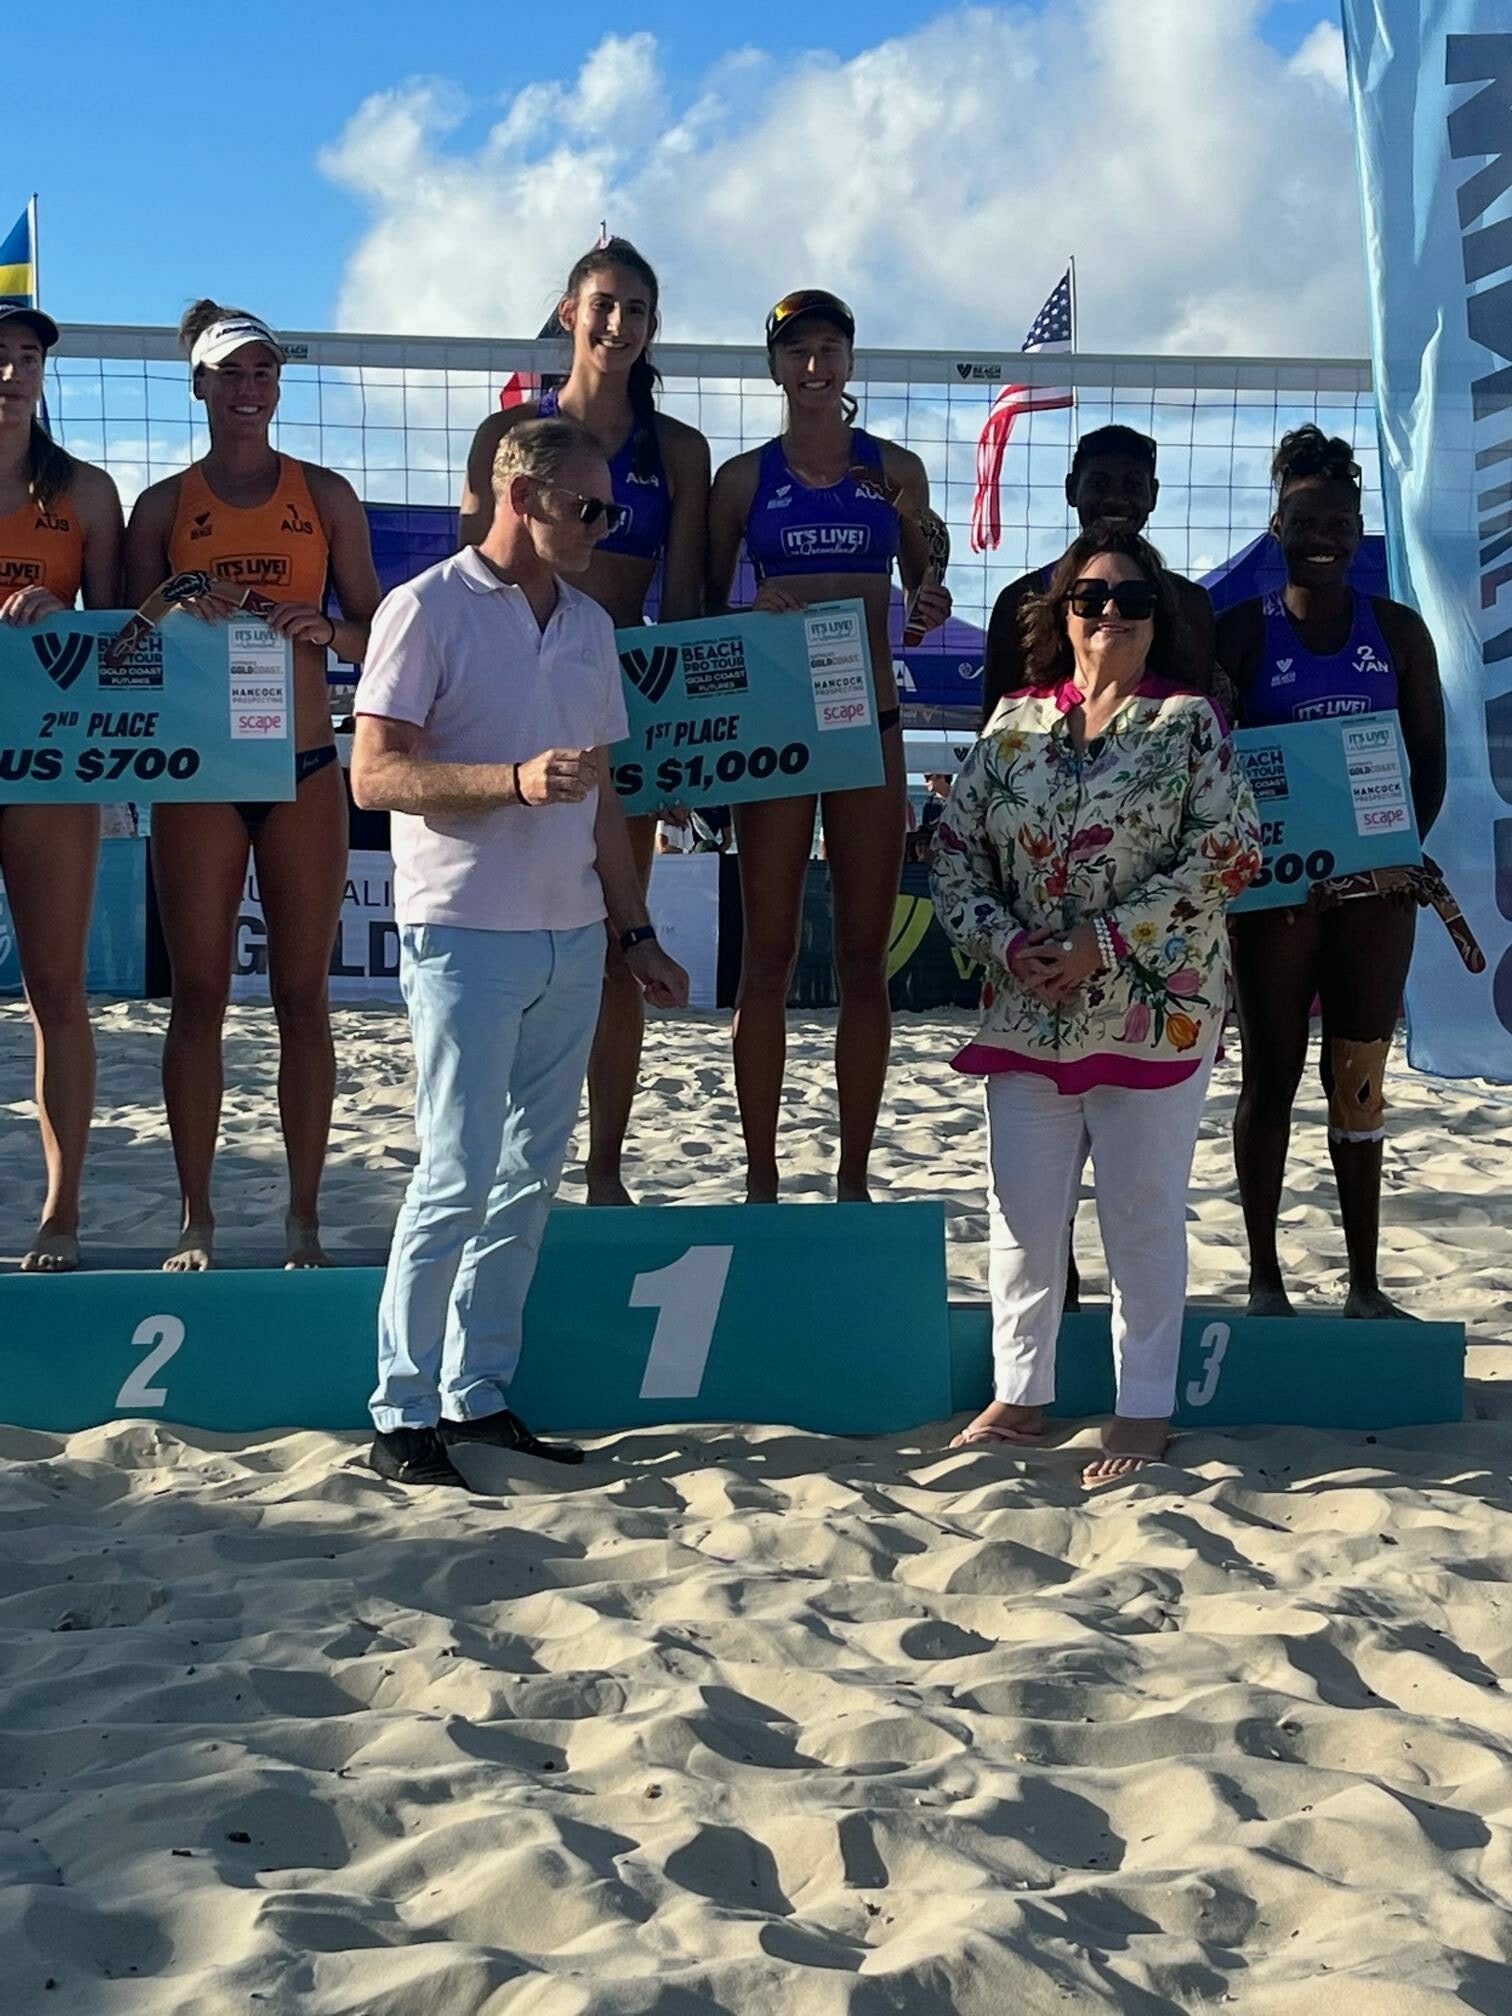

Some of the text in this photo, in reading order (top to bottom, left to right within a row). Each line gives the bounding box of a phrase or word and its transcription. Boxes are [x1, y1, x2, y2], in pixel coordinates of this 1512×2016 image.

[35, 517, 70, 532] AUS
[281, 519, 314, 535] AUS
[787, 528, 864, 547] IT'S LIVE!
[216, 558, 287, 577] IT'S LIVE!
[97, 637, 163, 652] BCH
[681, 640, 744, 662] BEACH
[1357, 645, 1376, 661] 2
[684, 656, 745, 673] PRO TOUR
[1352, 660, 1389, 673] VAN
[713, 670, 745, 681] COAST
[814, 675, 863, 690] HANCOCK
[231, 687, 284, 697] HANCOCK
[823, 703, 865, 725] scape
[38, 711, 160, 738] 2ND PLACE
[239, 715, 281, 734] scape
[645, 715, 740, 751] 1ST PLACE
[0, 747, 200, 783] US $700
[1247, 750, 1284, 768] ACH
[610, 742, 810, 796] S $1,000
[1251, 764, 1285, 777] TOUR
[1353, 783, 1401, 797] HANCOCK
[1363, 808, 1405, 828] scape
[1247, 849, 1335, 888] 500
[231, 915, 401, 977] GLD
[628, 1244, 734, 1400] 1
[115, 1314, 186, 1408] 2
[1185, 1321, 1231, 1407] 3
